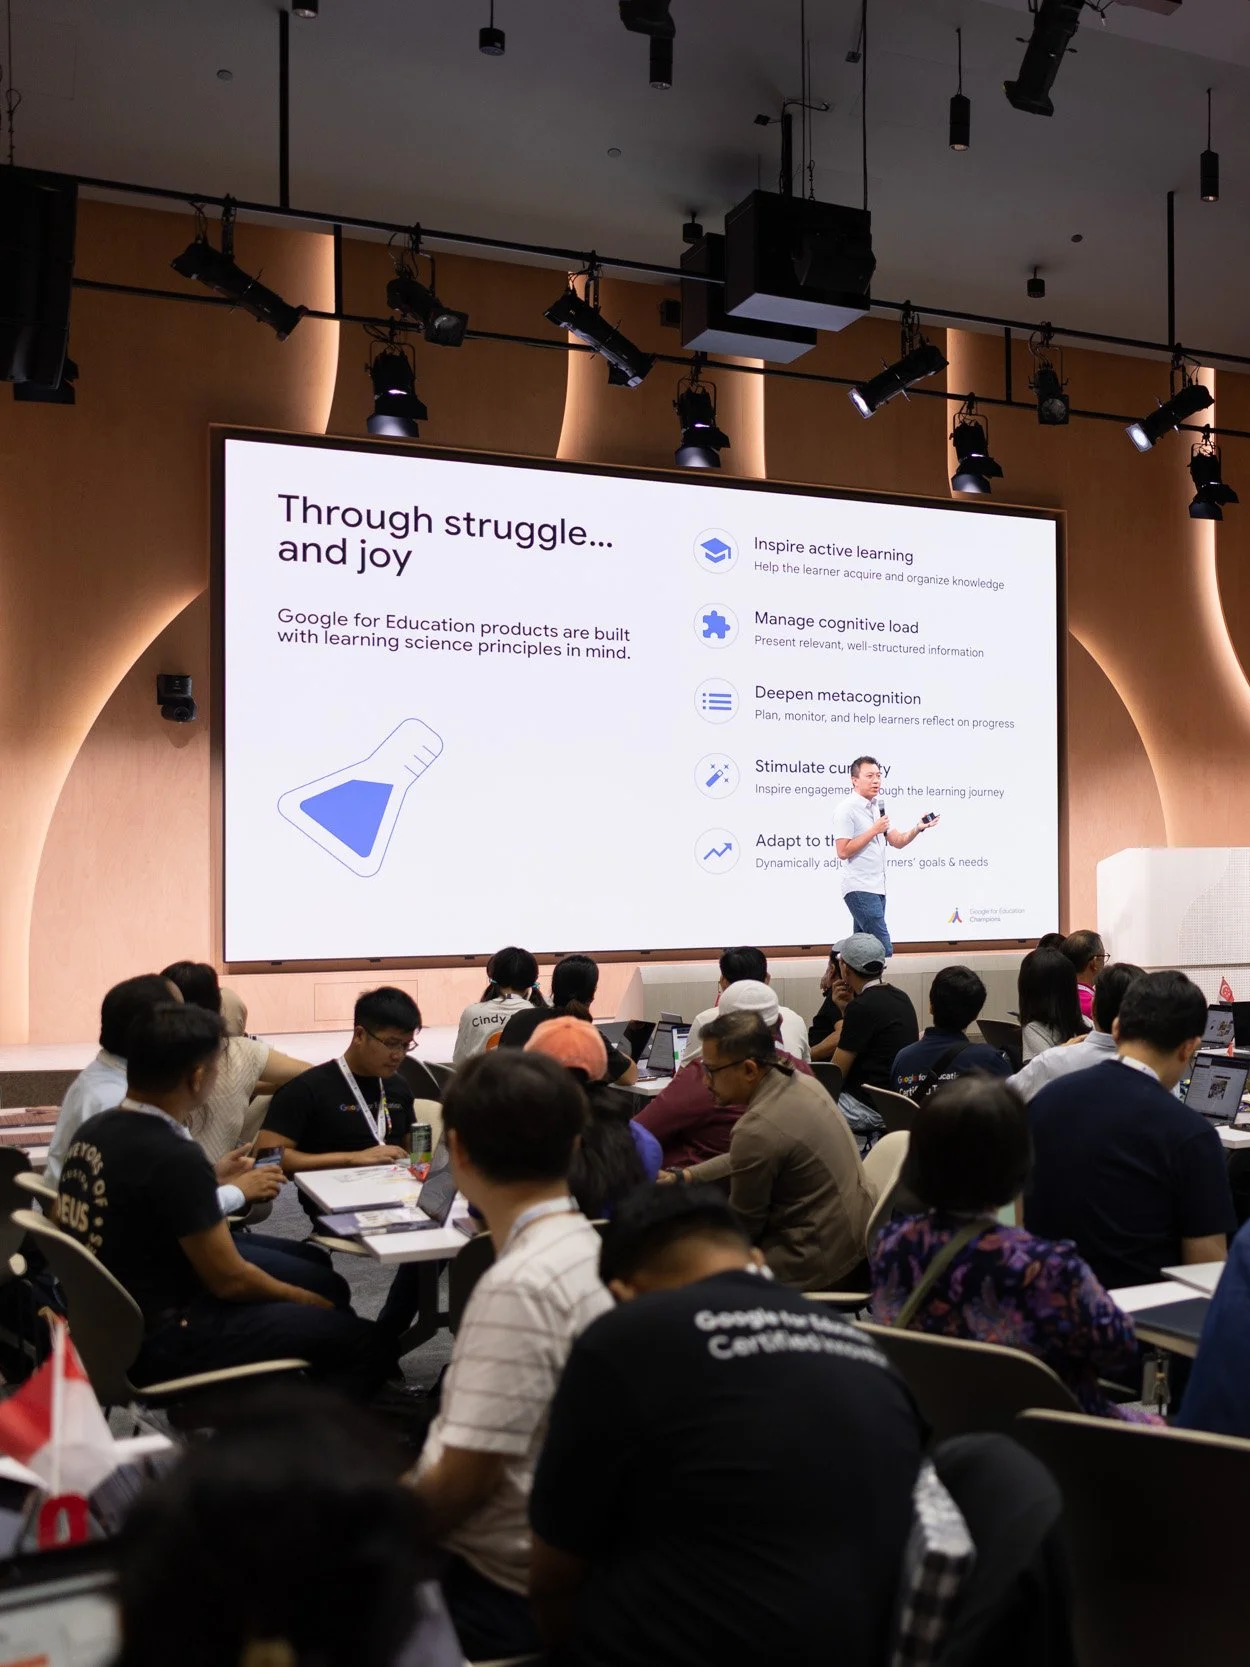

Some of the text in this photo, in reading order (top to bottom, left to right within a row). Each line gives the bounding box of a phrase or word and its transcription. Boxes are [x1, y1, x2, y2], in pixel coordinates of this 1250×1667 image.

[278, 493, 613, 552] Through struggle...
[278, 537, 413, 577] and joy
[754, 536, 914, 566] Inspire active learning
[754, 560, 1005, 592] Help the learner acquire and organize knowledge
[277, 607, 631, 642] Google for Education products are built
[754, 610, 919, 634] Manage cognitive load
[277, 628, 631, 660] with learning science principles in mind.
[754, 634, 985, 658] Present relevant, well-structured information
[755, 685, 922, 708] Deepen metacognition
[754, 708, 1015, 731] Plan, monitor, and help learners reflect on progress
[755, 759, 892, 779] Stimulate curty
[755, 782, 1005, 800] Inspire engageme ough the learning journey
[755, 833, 802, 851] Adapt
[804, 834, 821, 848] to
[755, 856, 821, 870] Dynamically
[886, 856, 916, 868] rners'
[918, 856, 947, 870] goals
[948, 856, 956, 868] &
[958, 856, 989, 867] needs
[969, 915, 1002, 923] Champions
[472, 1013, 507, 1028] Cindy
[56, 1192, 90, 1233] EUS
